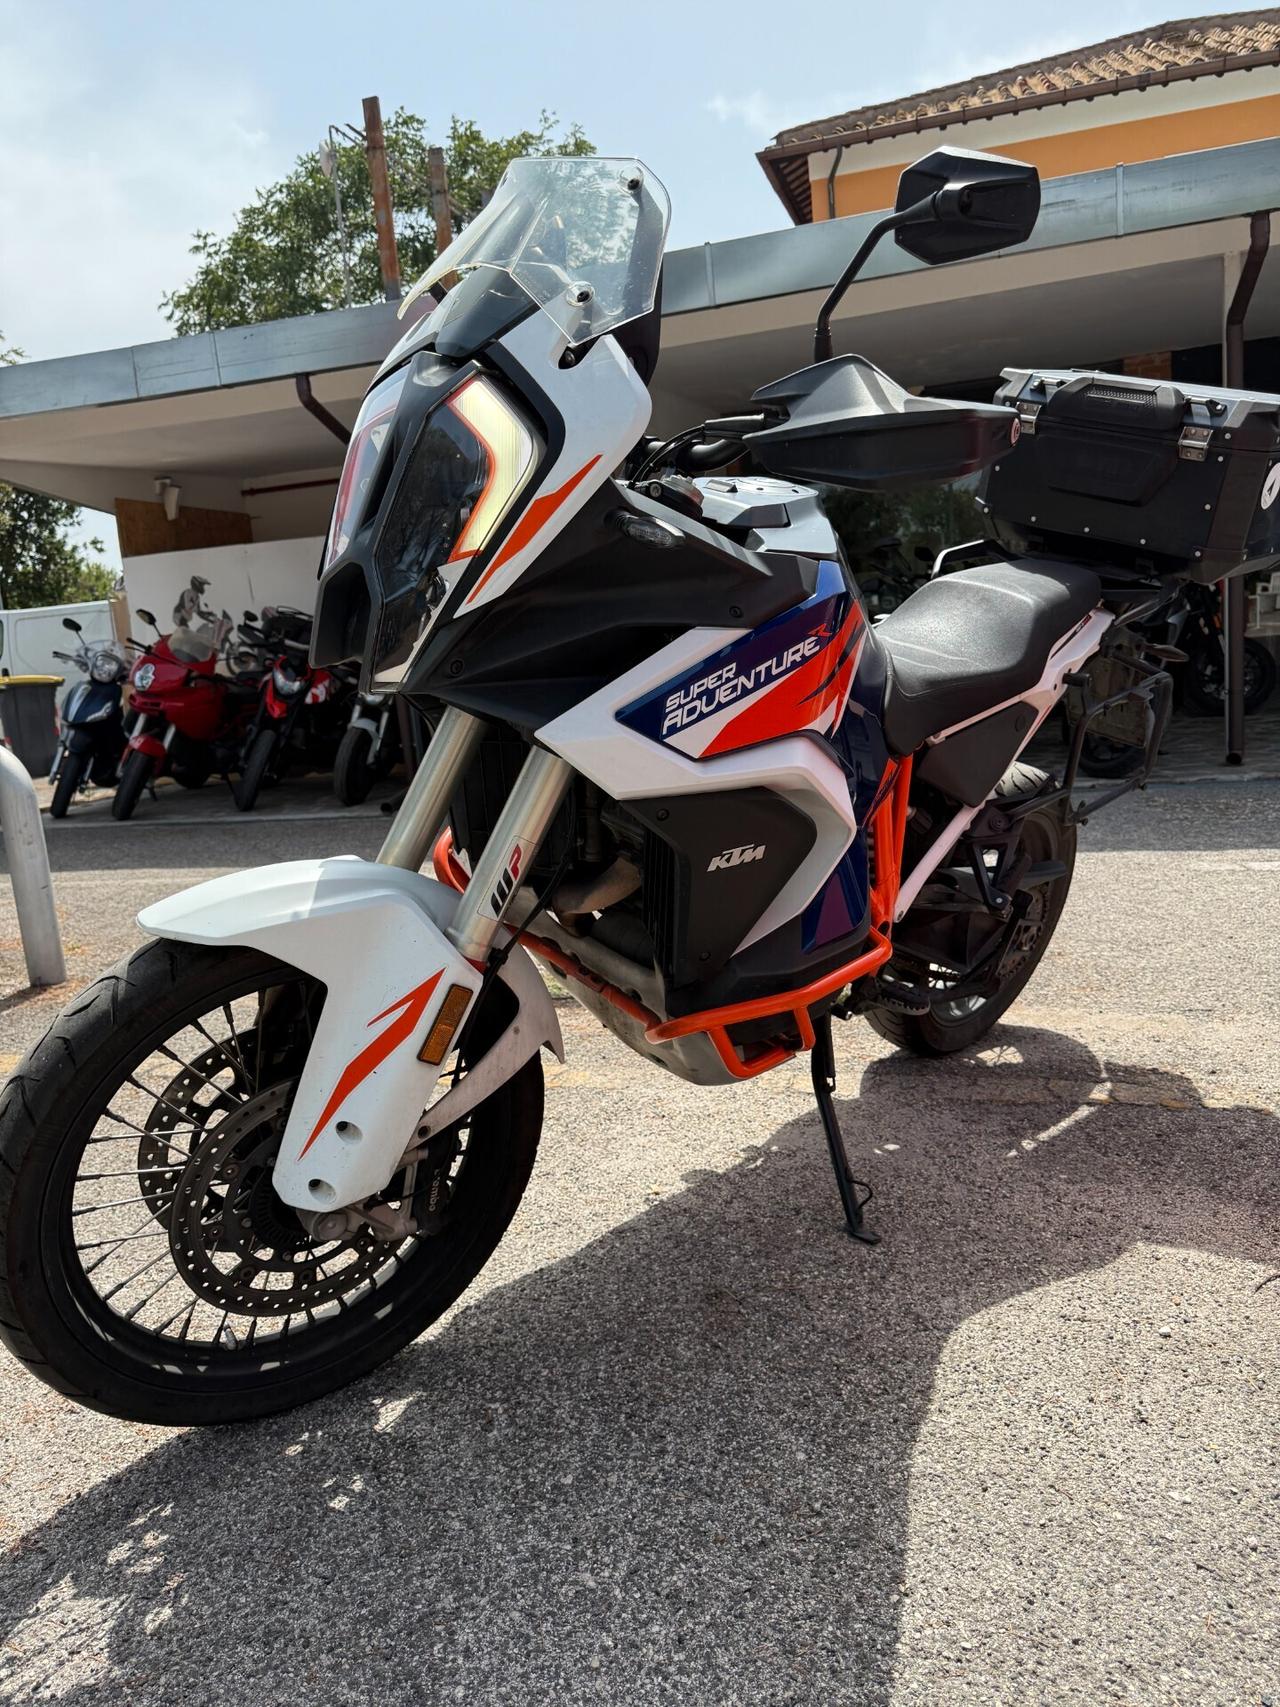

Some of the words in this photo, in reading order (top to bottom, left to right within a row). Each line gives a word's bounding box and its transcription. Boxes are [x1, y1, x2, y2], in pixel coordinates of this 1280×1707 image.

[661, 636, 821, 735] ADVENTURE
[664, 662, 737, 714] SUPER
[491, 843, 522, 918] WP
[707, 844, 766, 872] KTM
